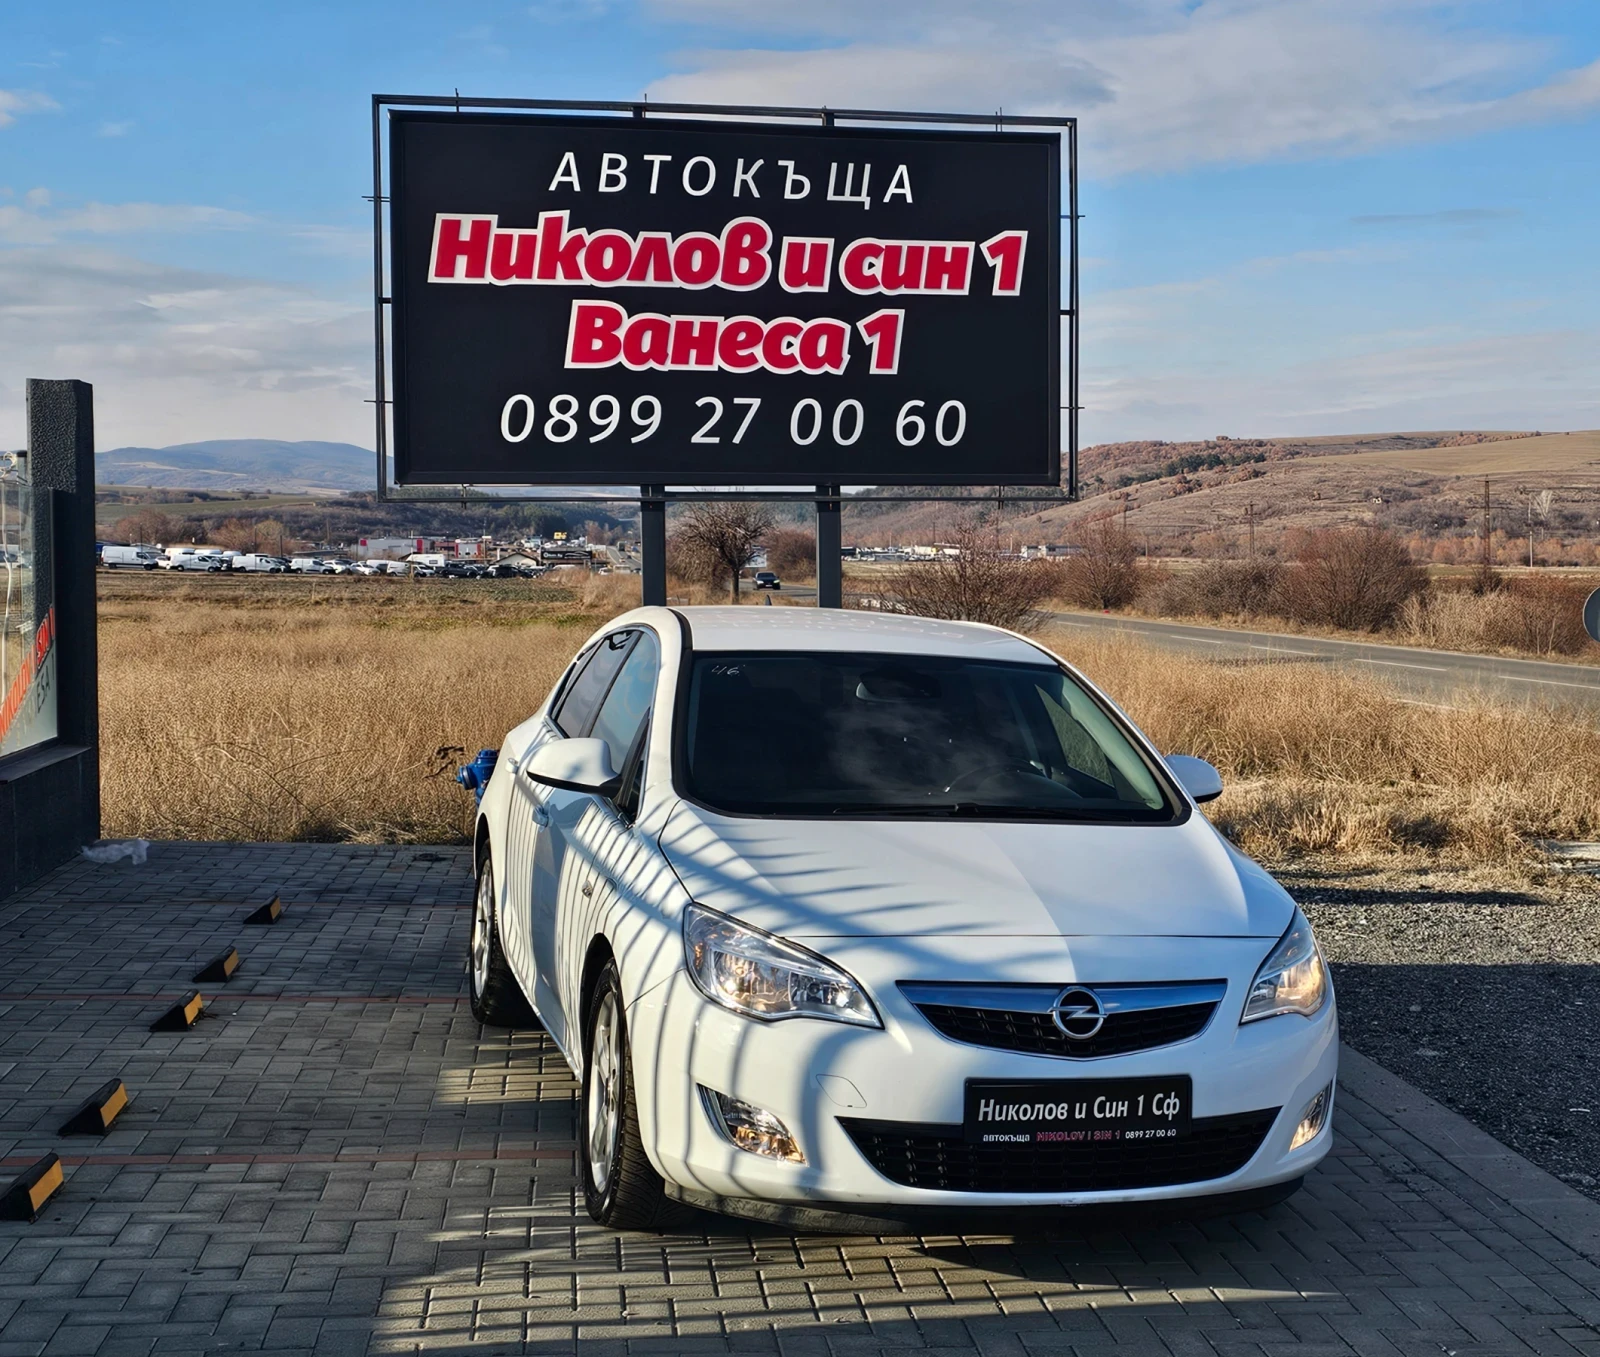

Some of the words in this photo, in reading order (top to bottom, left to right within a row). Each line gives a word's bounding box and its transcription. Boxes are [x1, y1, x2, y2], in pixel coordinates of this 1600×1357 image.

[549, 152, 913, 210] АВТОКЪЩА
[427, 209, 773, 292] Николов
[778, 236, 835, 293] и
[838, 237, 976, 295] син
[979, 230, 1028, 296] 1
[564, 299, 851, 375] Ванеса
[856, 308, 905, 374] 1
[500, 394, 662, 443] 0899
[690, 396, 762, 444] 27
[790, 398, 864, 446] 00
[895, 399, 967, 447] 60
[978, 1098, 1069, 1121] Николов
[1074, 1102, 1087, 1119] и
[1093, 1096, 1129, 1119] Син
[1137, 1094, 1145, 1117] 1
[1152, 1091, 1180, 1121] Сф
[982, 1133, 1030, 1143] автокъща
[1036, 1131, 1086, 1142] NIKOLOV
[1125, 1130, 1144, 1139] 0899
[1145, 1129, 1155, 1138] 27
[1156, 1129, 1165, 1137] 00
